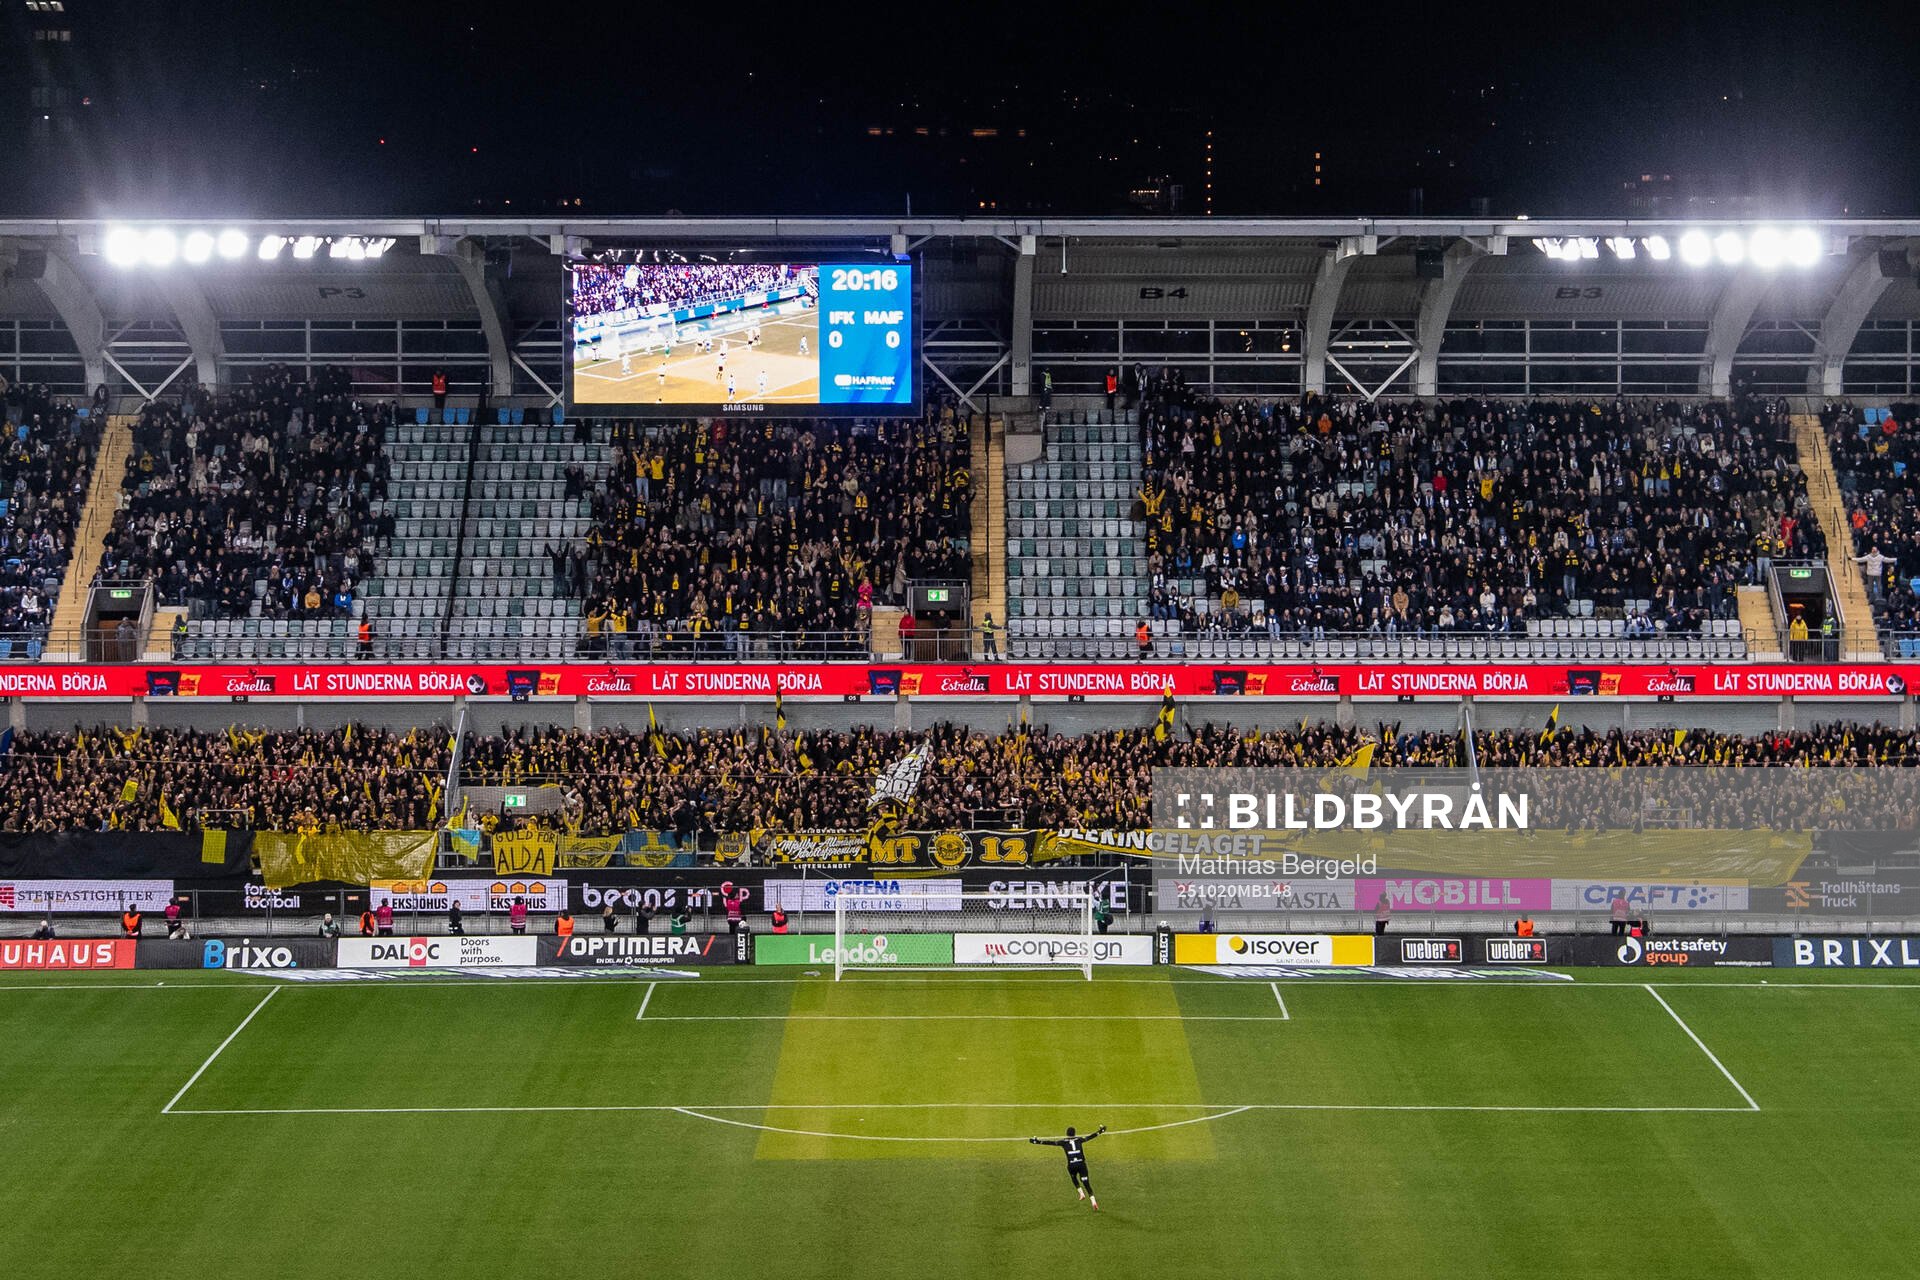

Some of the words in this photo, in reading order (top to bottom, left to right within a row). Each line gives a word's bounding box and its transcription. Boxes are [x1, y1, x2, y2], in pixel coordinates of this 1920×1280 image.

[832, 269, 898, 291] 20:16
[319, 288, 365, 298] P3
[1140, 288, 1188, 299] B4
[1555, 288, 1602, 299] B3
[829, 311, 855, 325] IFK
[863, 310, 904, 325] MAIF
[829, 331, 843, 348] 0
[886, 331, 900, 348] 0
[62, 672, 107, 690] BÖRJA
[227, 679, 271, 692] Estrella
[294, 671, 320, 690] LÅT
[327, 674, 412, 690] STUNDERNA
[419, 671, 464, 690] BÖRJA
[587, 678, 631, 691] Estrella
[653, 670, 678, 690] LÅT
[686, 673, 771, 690] STUNDERNA
[941, 678, 985, 691] Estrella
[1006, 670, 1032, 690] LÅT
[1039, 673, 1124, 690] STUNDERNA
[1291, 678, 1335, 691] Estrella
[1359, 671, 1384, 690] LÅT
[1391, 674, 1477, 690] STUNDERNA
[1483, 671, 1528, 690] BÖRJA
[1647, 678, 1692, 692] Estrella
[1714, 670, 1740, 690] LÅT
[1747, 674, 1832, 690] STUNDERNA
[1839, 671, 1882, 690] BÖRJA
[870, 836, 921, 863] MT
[980, 836, 1028, 864] 12
[497, 847, 545, 873] ALDA
[17, 890, 154, 901] STENFASTIGHETER
[583, 882, 675, 908] beans
[688, 888, 712, 908] in
[842, 880, 900, 895] STENA
[1385, 881, 1521, 904] MOBILL
[1584, 884, 1686, 904] CRAFT
[1820, 881, 1901, 894] Trollhättans
[244, 896, 300, 908] football
[490, 897, 546, 909] EKSHUS
[1276, 892, 1342, 908] RASTA
[1821, 895, 1857, 907] Truck
[461, 938, 490, 946] Doors
[571, 937, 701, 956] OPTIMERA
[737, 933, 746, 960] SELECT
[1160, 933, 1169, 964] SELECT
[1251, 941, 1320, 955] isover
[1406, 940, 1447, 959] weber
[1490, 940, 1531, 959] weber
[1646, 940, 1679, 951] next
[1681, 939, 1727, 955] safety
[371, 944, 440, 960] DALOC
[461, 947, 482, 955] with
[1646, 952, 1688, 965] group
[1794, 939, 1920, 965] BRIXL
[460, 956, 503, 965] purpose.
[1069, 1140, 1077, 1151] 1
